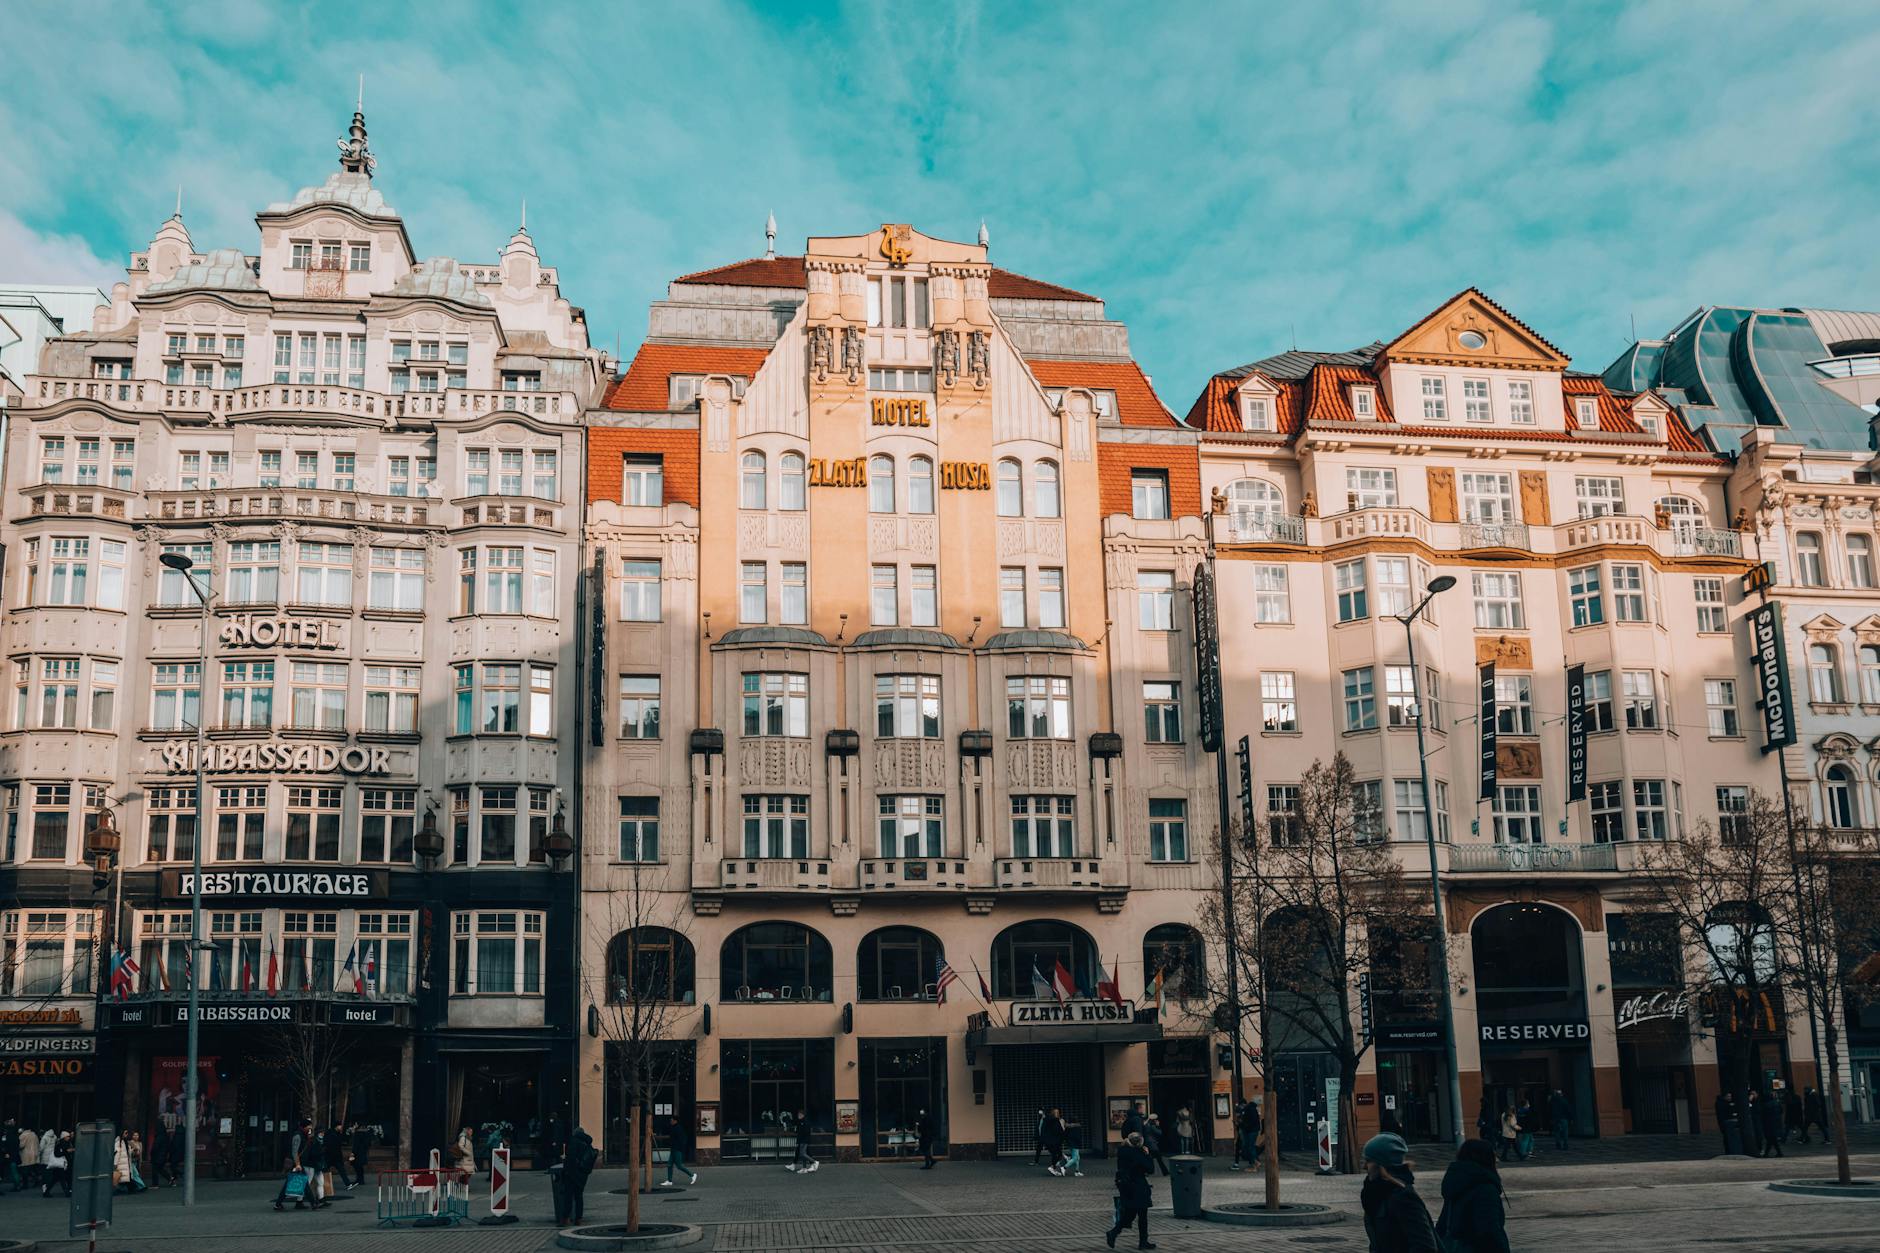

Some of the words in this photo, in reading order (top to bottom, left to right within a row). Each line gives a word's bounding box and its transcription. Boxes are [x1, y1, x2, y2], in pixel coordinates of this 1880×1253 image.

[871, 397, 931, 428] HOTEL
[940, 461, 992, 490] HUSA
[219, 614, 340, 649] HOTEL
[1758, 609, 1785, 740] McDonald's
[1482, 678, 1495, 781] MOHITO
[1571, 684, 1583, 784] RESERVED
[162, 739, 392, 775] AMBASSADOR
[180, 873, 369, 895] RESTAURACE
[122, 1009, 142, 1022] hotel
[345, 1009, 377, 1022] hotel
[1018, 1004, 1074, 1021] ZLATÁ
[1081, 1006, 1129, 1020] HUSA
[1482, 1024, 1589, 1041] RESERVED
